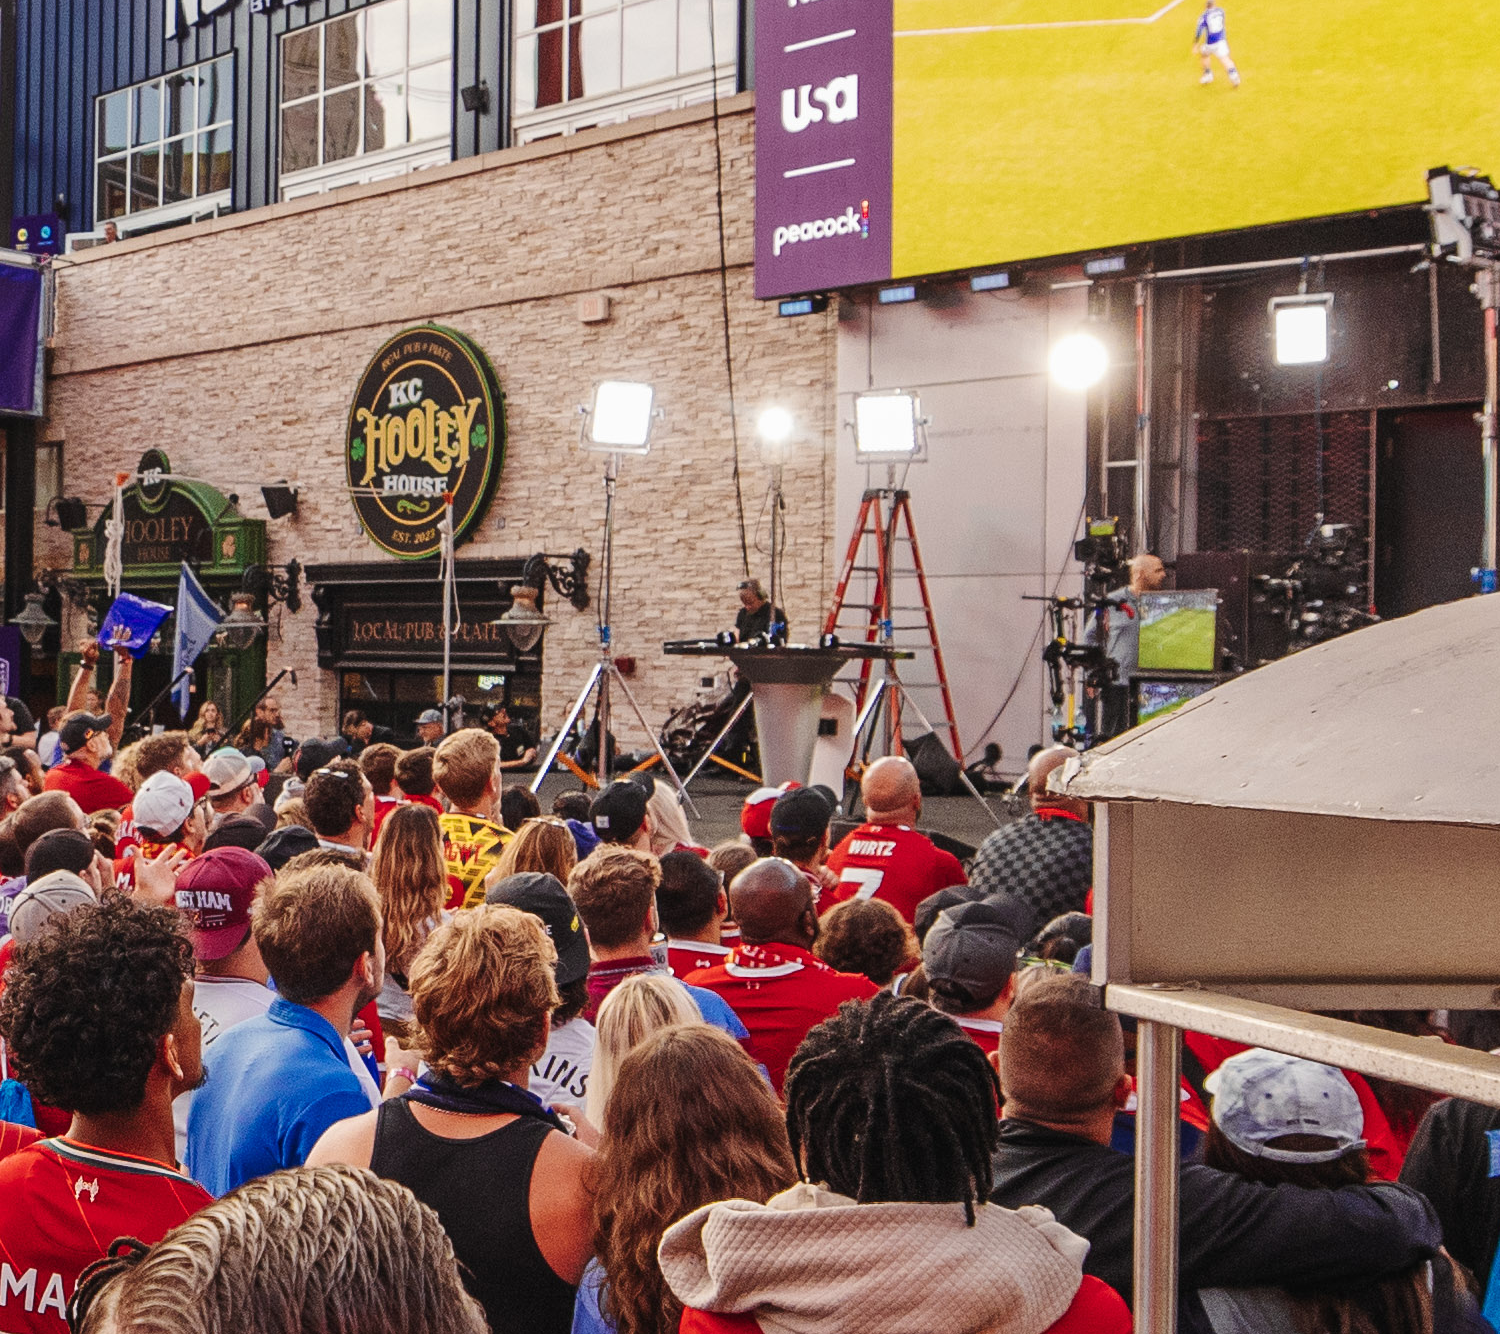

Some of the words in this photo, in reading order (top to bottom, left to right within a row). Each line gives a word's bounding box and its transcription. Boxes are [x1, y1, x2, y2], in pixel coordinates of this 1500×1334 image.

[772, 205, 862, 257] peacock
[387, 377, 424, 409] KC
[356, 396, 482, 485] HOOLEY
[141, 466, 164, 486] KC
[382, 474, 450, 498] HOUSE
[352, 619, 400, 642] LOCAL
[404, 622, 433, 642] PUB
[847, 838, 898, 858] WIRTZ
[839, 867, 886, 901] 7
[198, 890, 232, 913] HAM
